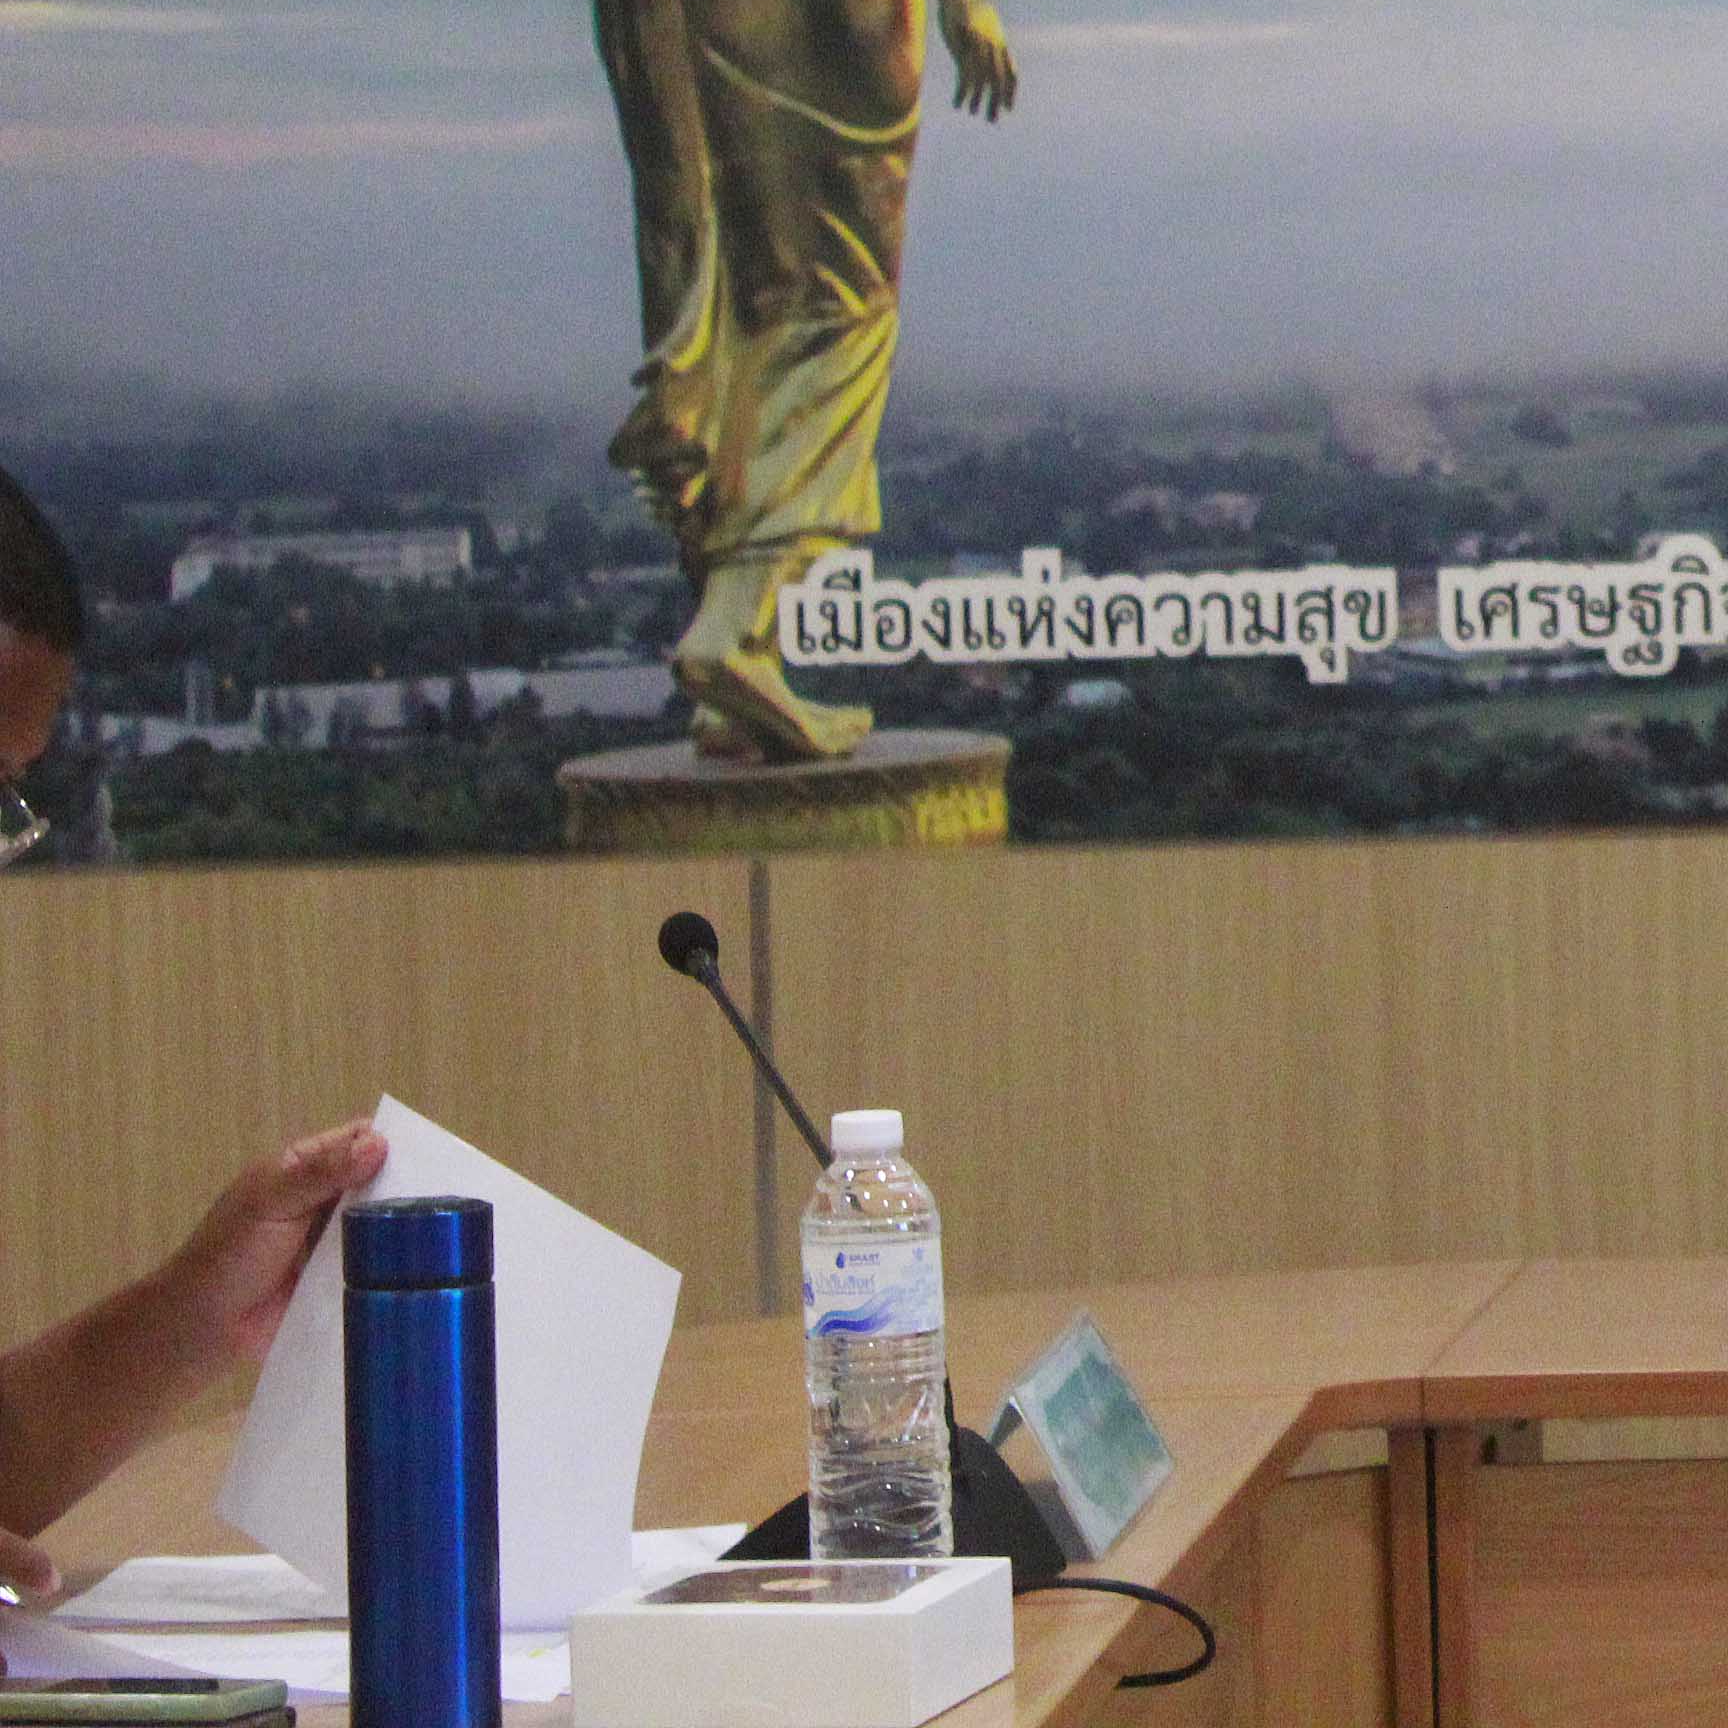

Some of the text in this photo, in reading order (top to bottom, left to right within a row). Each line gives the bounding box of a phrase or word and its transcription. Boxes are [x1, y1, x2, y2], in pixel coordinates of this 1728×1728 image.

[797, 566, 1391, 674] เมืองแห่งความสุข
